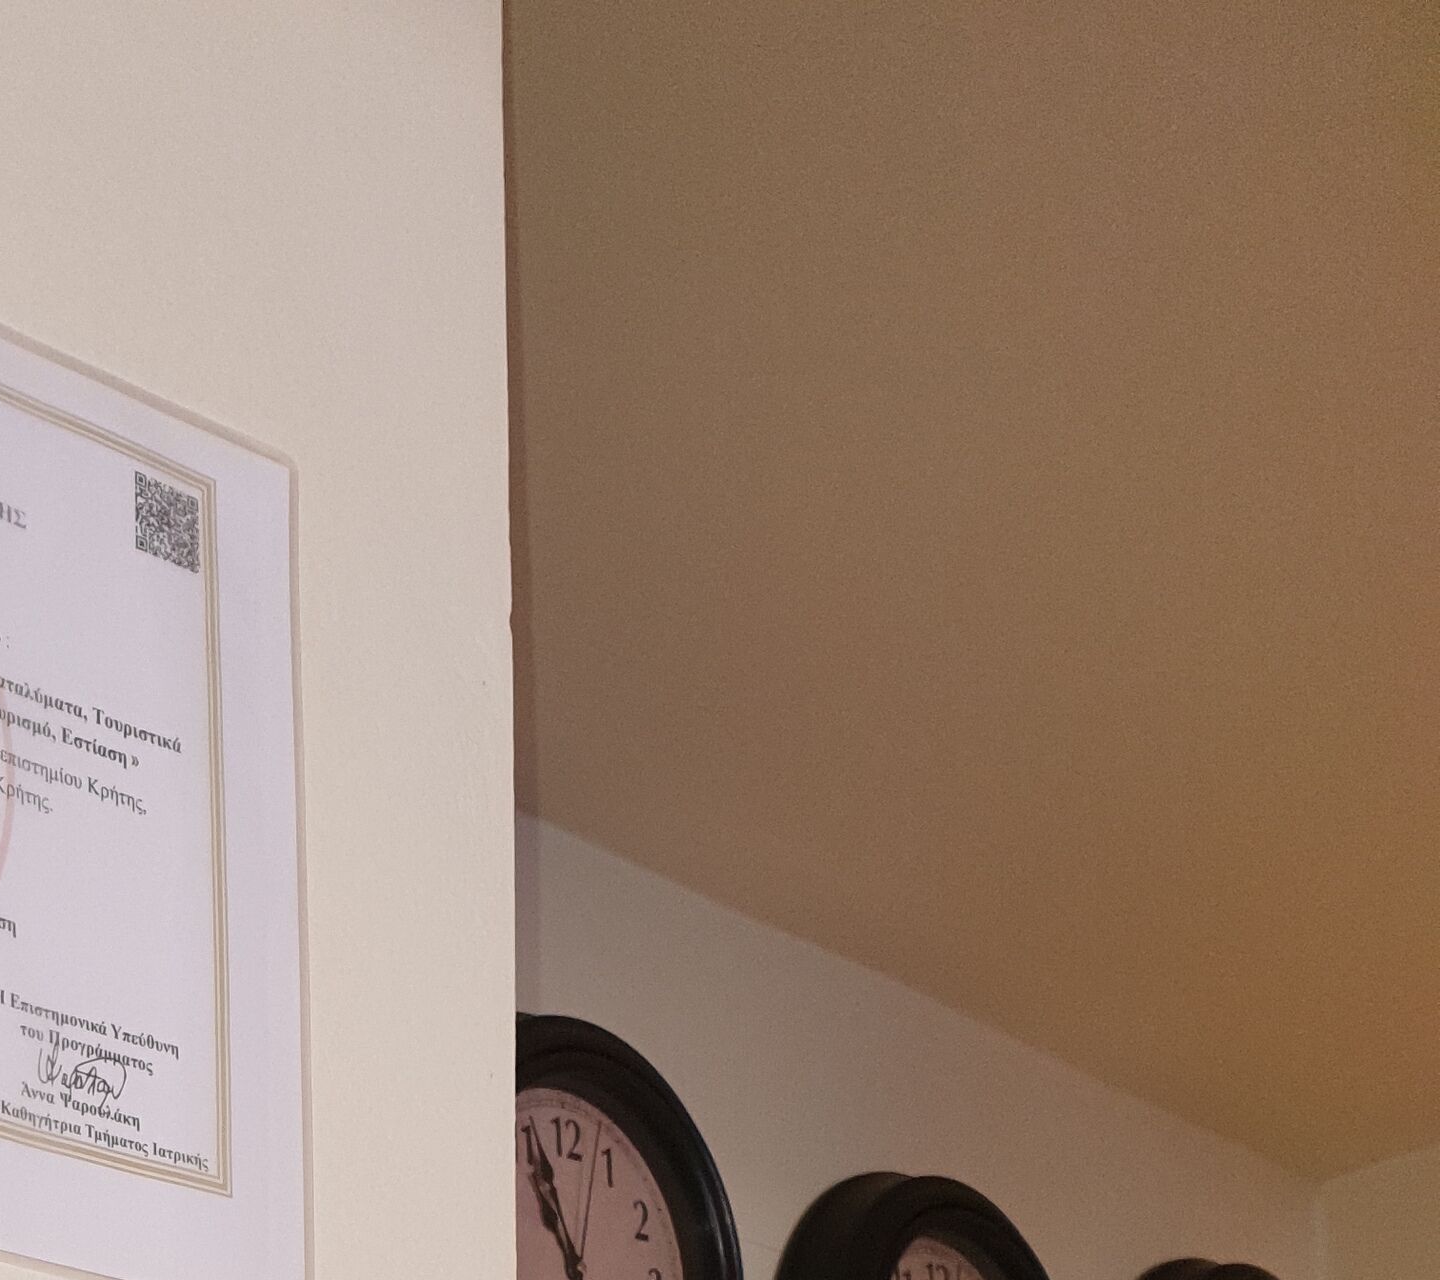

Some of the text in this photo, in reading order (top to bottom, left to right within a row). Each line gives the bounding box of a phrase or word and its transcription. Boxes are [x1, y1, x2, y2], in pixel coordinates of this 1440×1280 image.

[550, 1116, 583, 1162] 12
[601, 1147, 615, 1189] 1
[633, 1200, 650, 1243] 2
